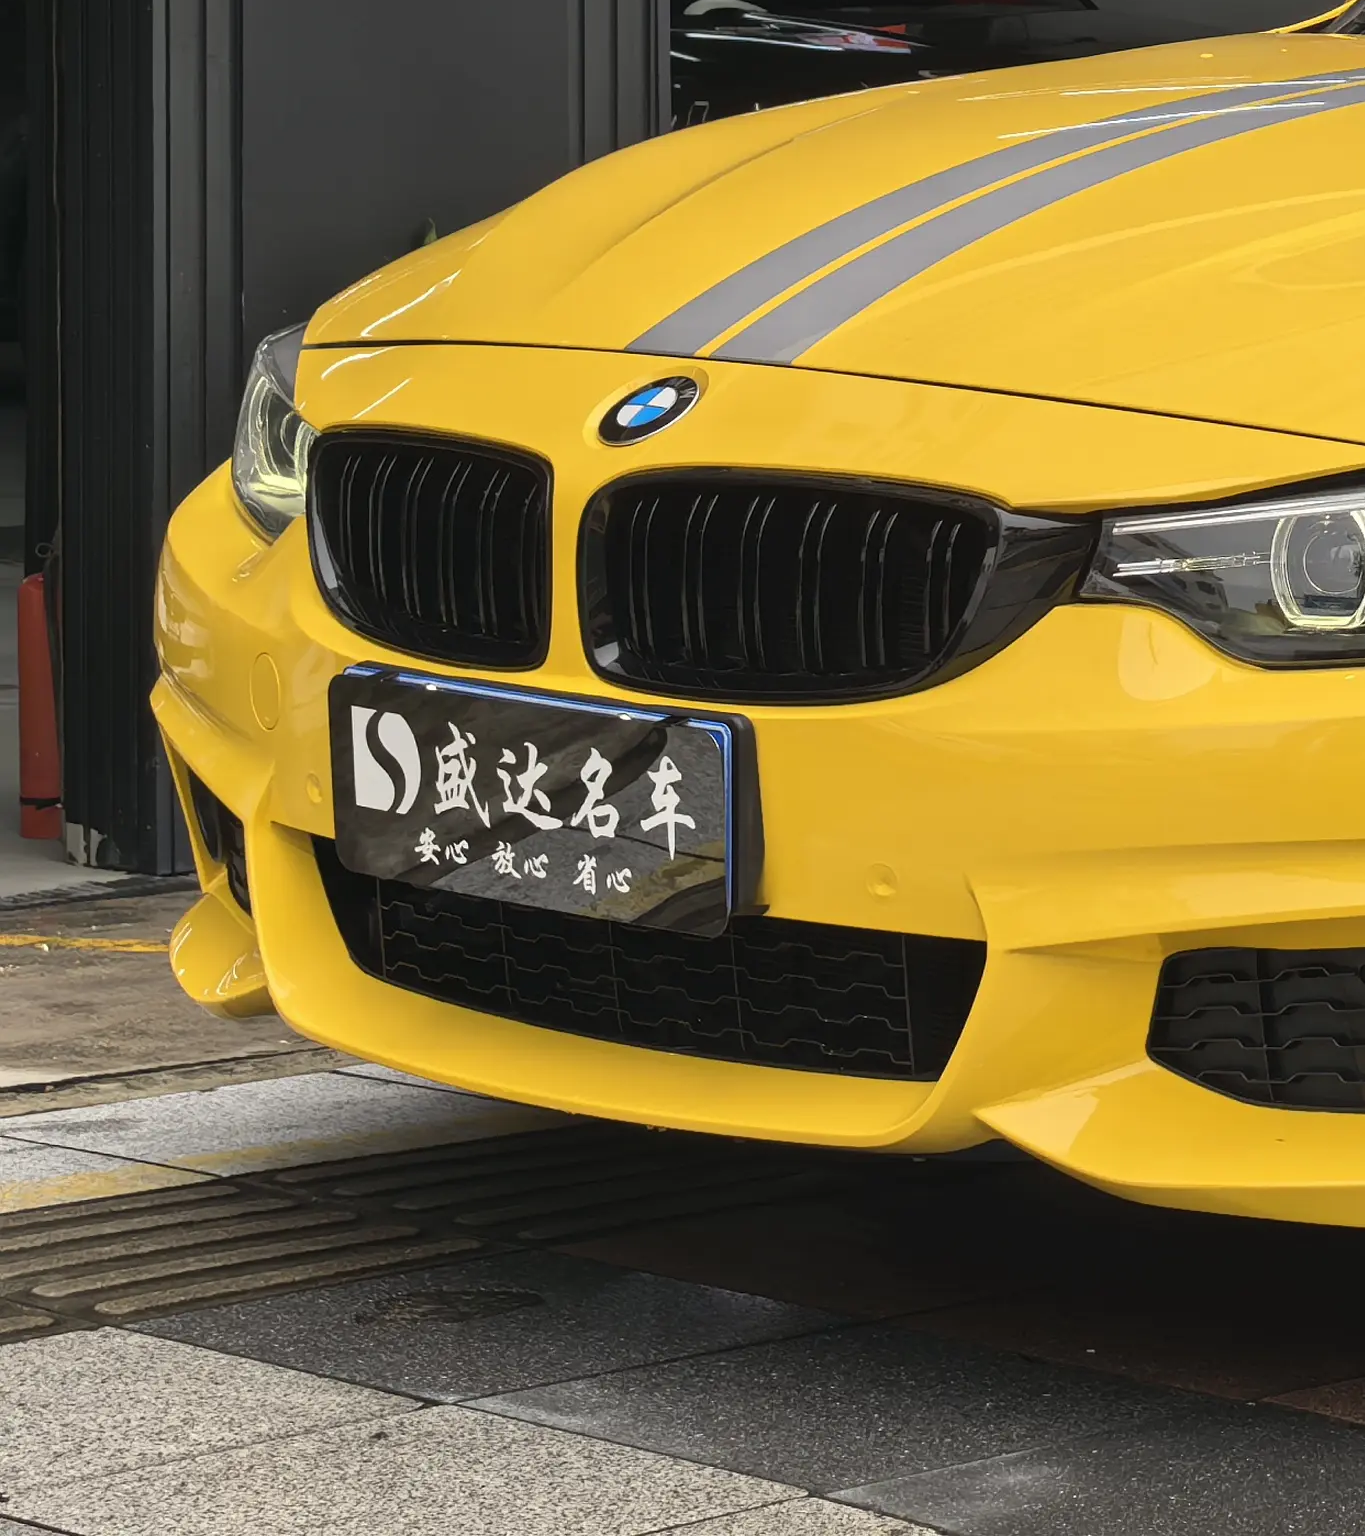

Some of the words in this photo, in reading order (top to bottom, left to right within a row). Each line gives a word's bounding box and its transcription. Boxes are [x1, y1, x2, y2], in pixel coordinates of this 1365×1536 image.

[433, 720, 697, 861] 盛达名车
[414, 827, 470, 865] 安心
[491, 840, 550, 880] 放心
[572, 853, 632, 896] 省心
